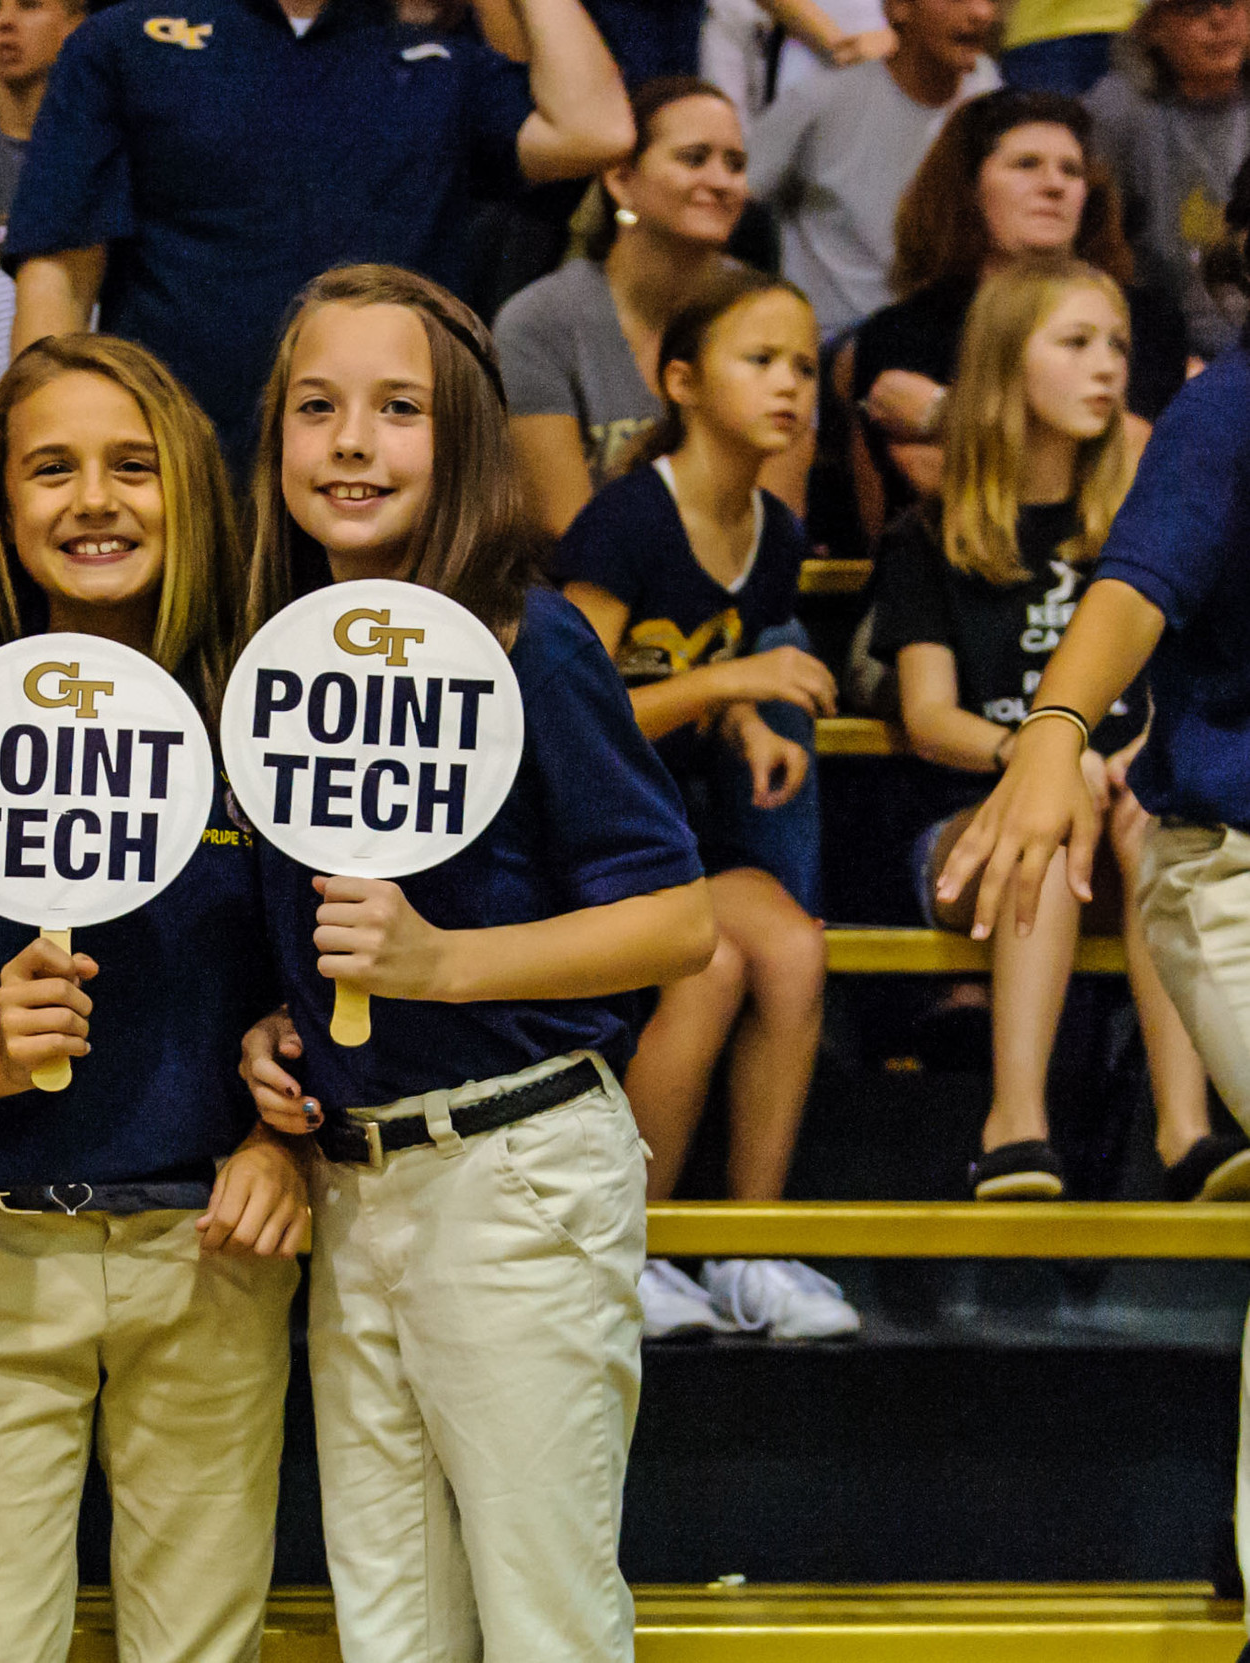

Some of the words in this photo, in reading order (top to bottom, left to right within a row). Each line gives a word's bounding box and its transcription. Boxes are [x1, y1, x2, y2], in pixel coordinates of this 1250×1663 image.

[333, 608, 425, 667] GT
[23, 661, 115, 719] GT
[253, 669, 495, 750] POINT
[264, 753, 468, 835] TECH
[202, 828, 240, 846] PRIDE
